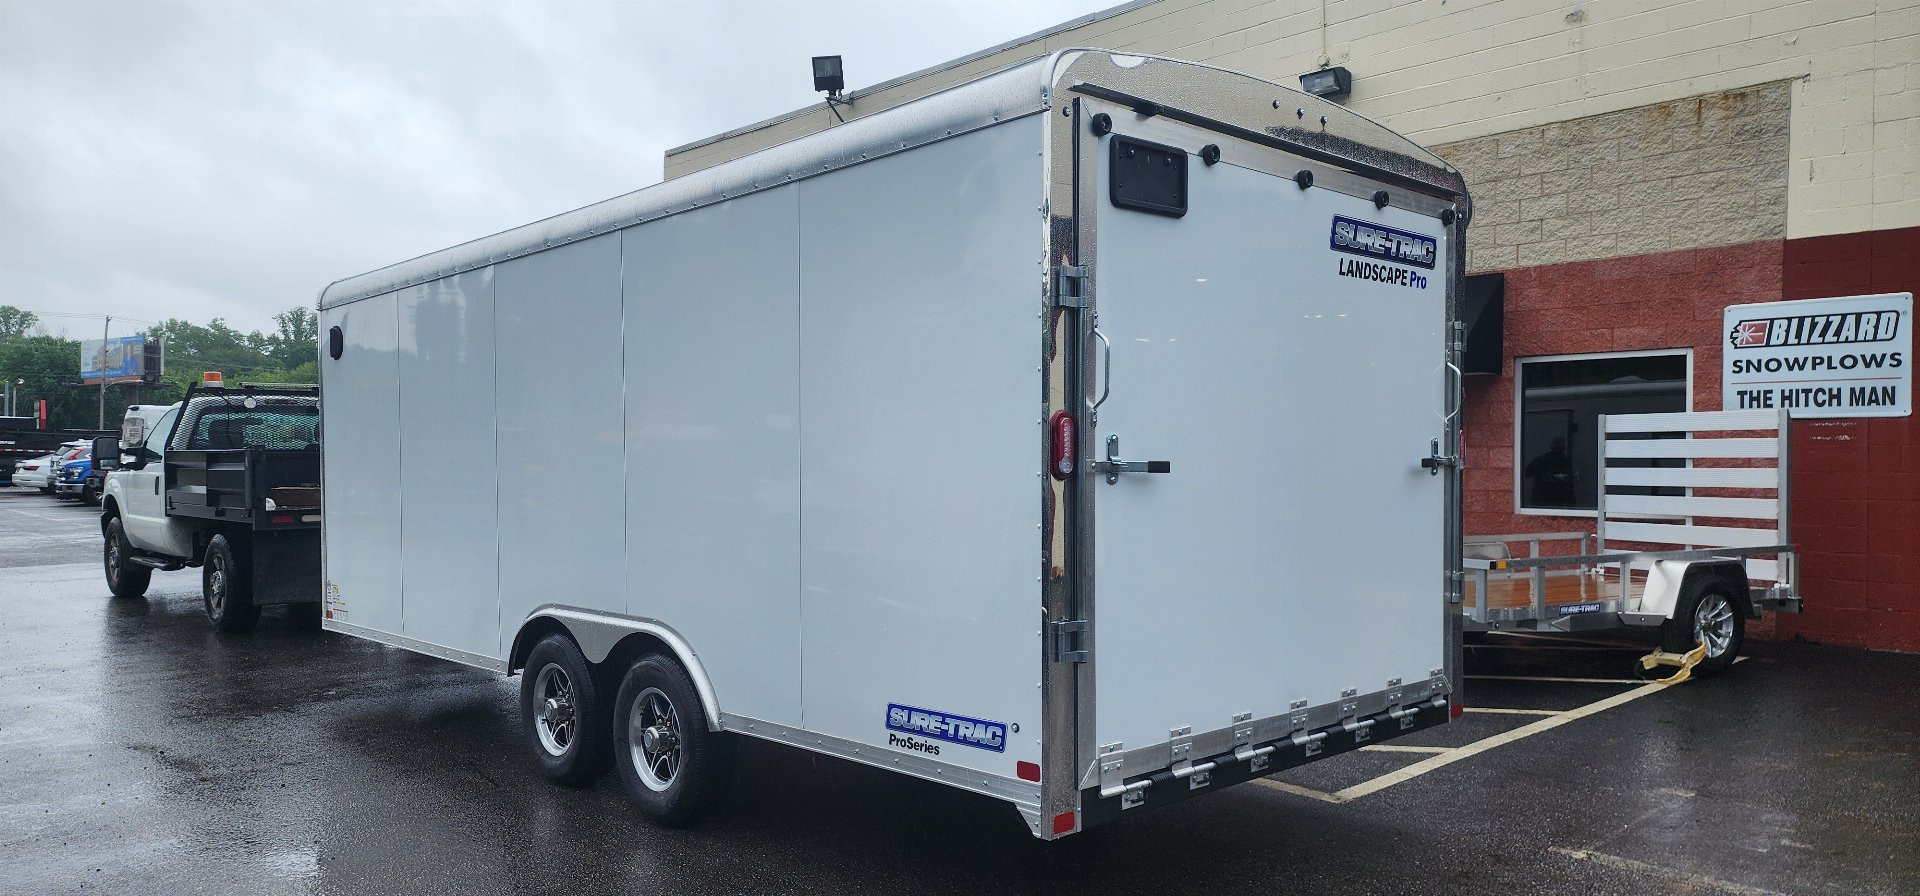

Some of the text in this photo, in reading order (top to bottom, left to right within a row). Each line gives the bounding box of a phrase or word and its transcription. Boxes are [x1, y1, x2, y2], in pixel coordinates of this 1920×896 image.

[1335, 222, 1434, 263] SURE-TRAC
[1339, 258, 1427, 289] LANDSCAPE Pro
[1769, 312, 1898, 346] BLIZZARD
[1732, 352, 1902, 374] SNOWPLOWS
[1737, 386, 1896, 409] THE HITCH MAN
[1560, 604, 1600, 615] SURE-TRAC
[889, 707, 1003, 747] SURE-TRAC
[889, 733, 940, 755] ProSeries
